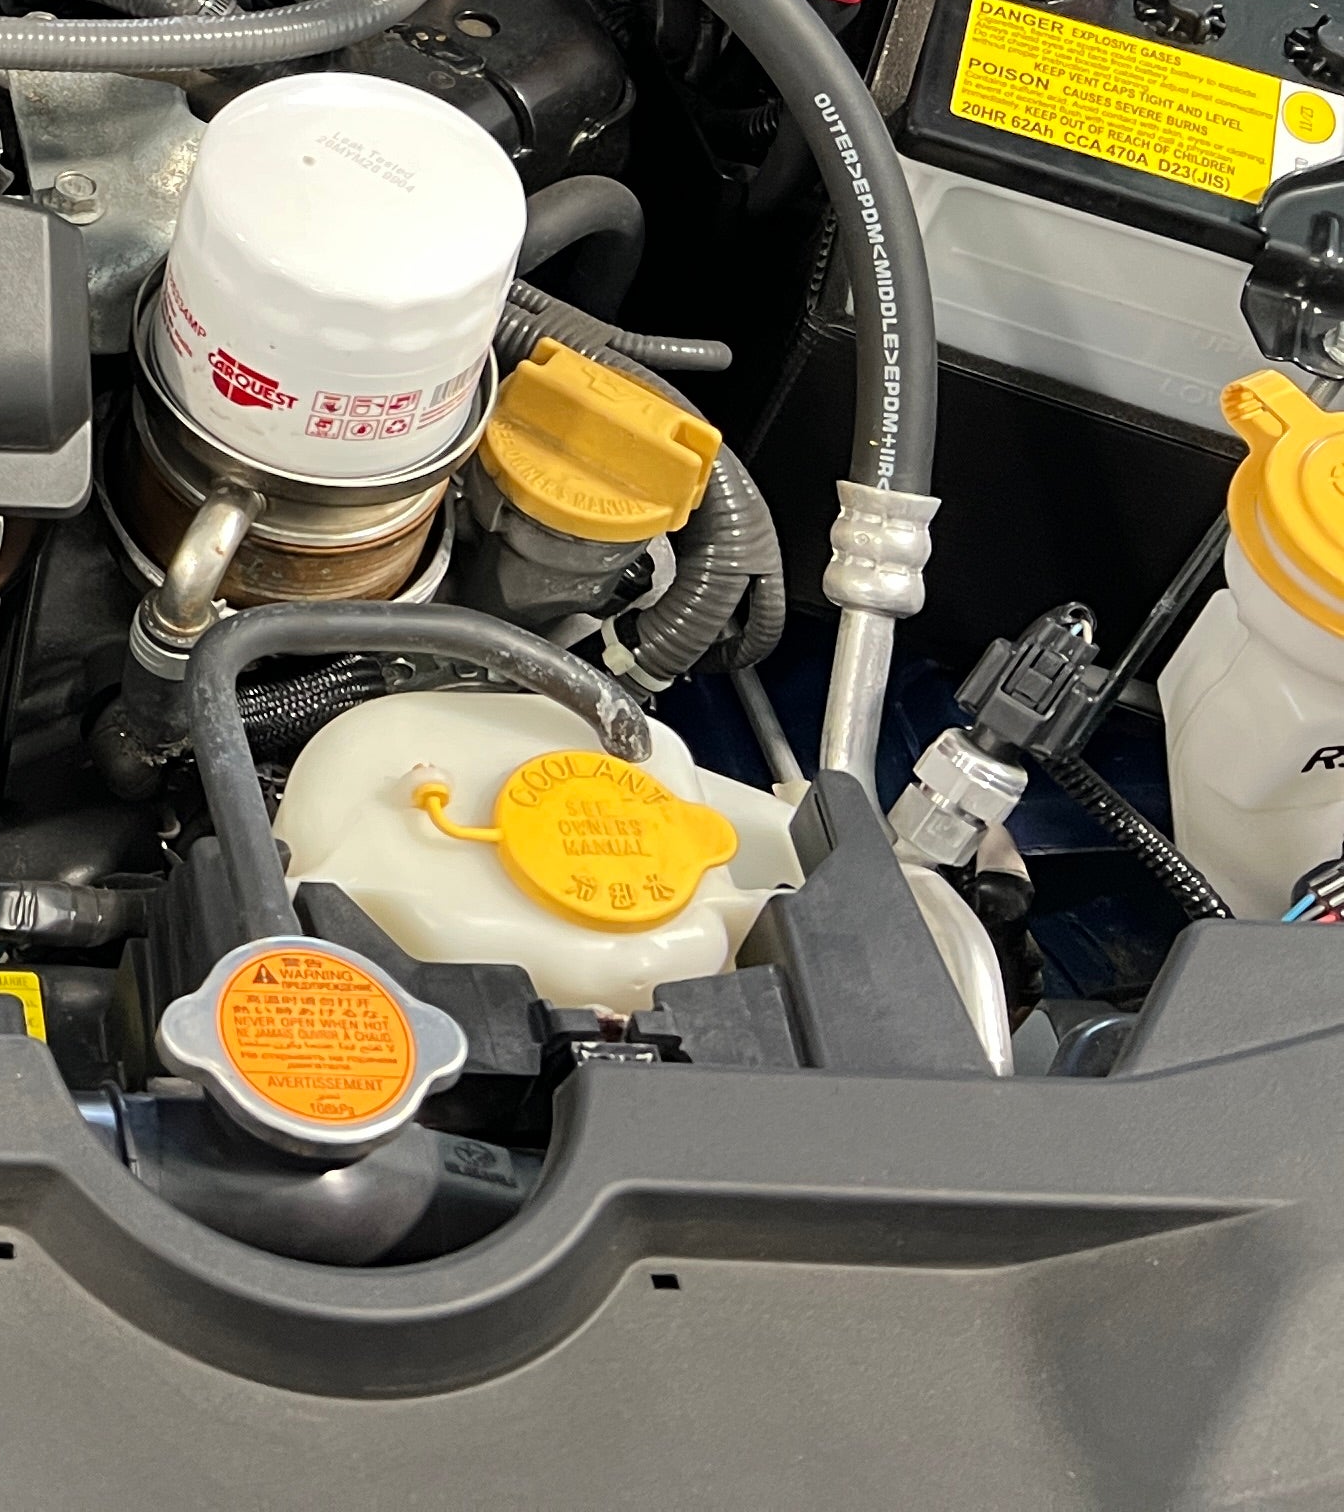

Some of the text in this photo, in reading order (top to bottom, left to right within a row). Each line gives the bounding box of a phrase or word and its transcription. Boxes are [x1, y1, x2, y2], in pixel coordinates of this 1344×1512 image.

[979, 1, 1182, 66] DANGER EXPLOSIVE GASES
[968, 56, 1208, 136] POISON CAUSES SEVERE BURNS
[1033, 61, 1244, 131] KEEP VENT CAPS TIGHT AND LEVEL
[960, 99, 1231, 193] 20HR 62Ah CCA 470A D23(JIS)
[1023, 105, 1057, 124] KEEP
[1059, 116, 1085, 132] OUT
[1087, 124, 1104, 138] OF
[1108, 129, 1150, 150] REACH
[1152, 142, 1170, 156] OF
[1172, 148, 1236, 175] CHILDREN
[207, 350, 299, 410] CARQUEST
[509, 756, 672, 808] COOLANT
[1301, 746, 1344, 773] R
[279, 968, 353, 982] WARNING
[234, 1016, 389, 1031] NEVER OPEN WHEN HOT
[268, 1076, 383, 1091] AVERTISSEMENT
